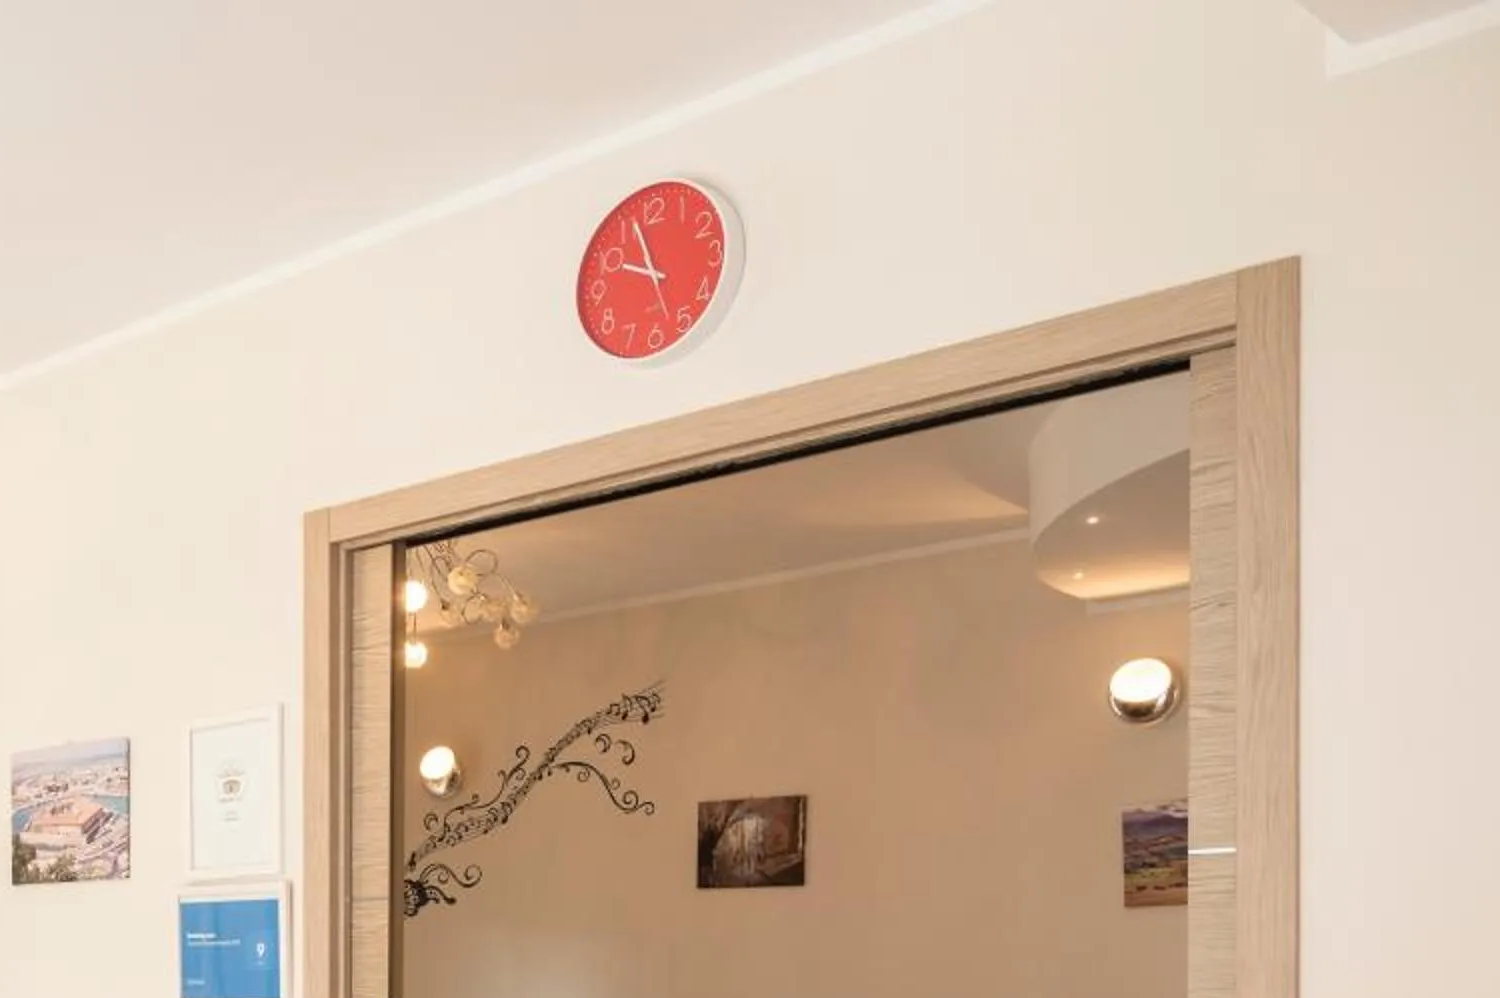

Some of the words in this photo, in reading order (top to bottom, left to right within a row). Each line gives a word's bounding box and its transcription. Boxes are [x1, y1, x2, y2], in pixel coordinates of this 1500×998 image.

[643, 198, 665, 225] 12
[679, 196, 686, 223] 1
[694, 211, 715, 239] 2
[601, 247, 624, 276] 10
[707, 240, 723, 267] 3
[591, 279, 607, 305] 9
[695, 275, 711, 301] 4
[601, 308, 615, 335] 8
[675, 305, 692, 333] 5
[622, 323, 637, 350] 7
[647, 323, 665, 349] 6
